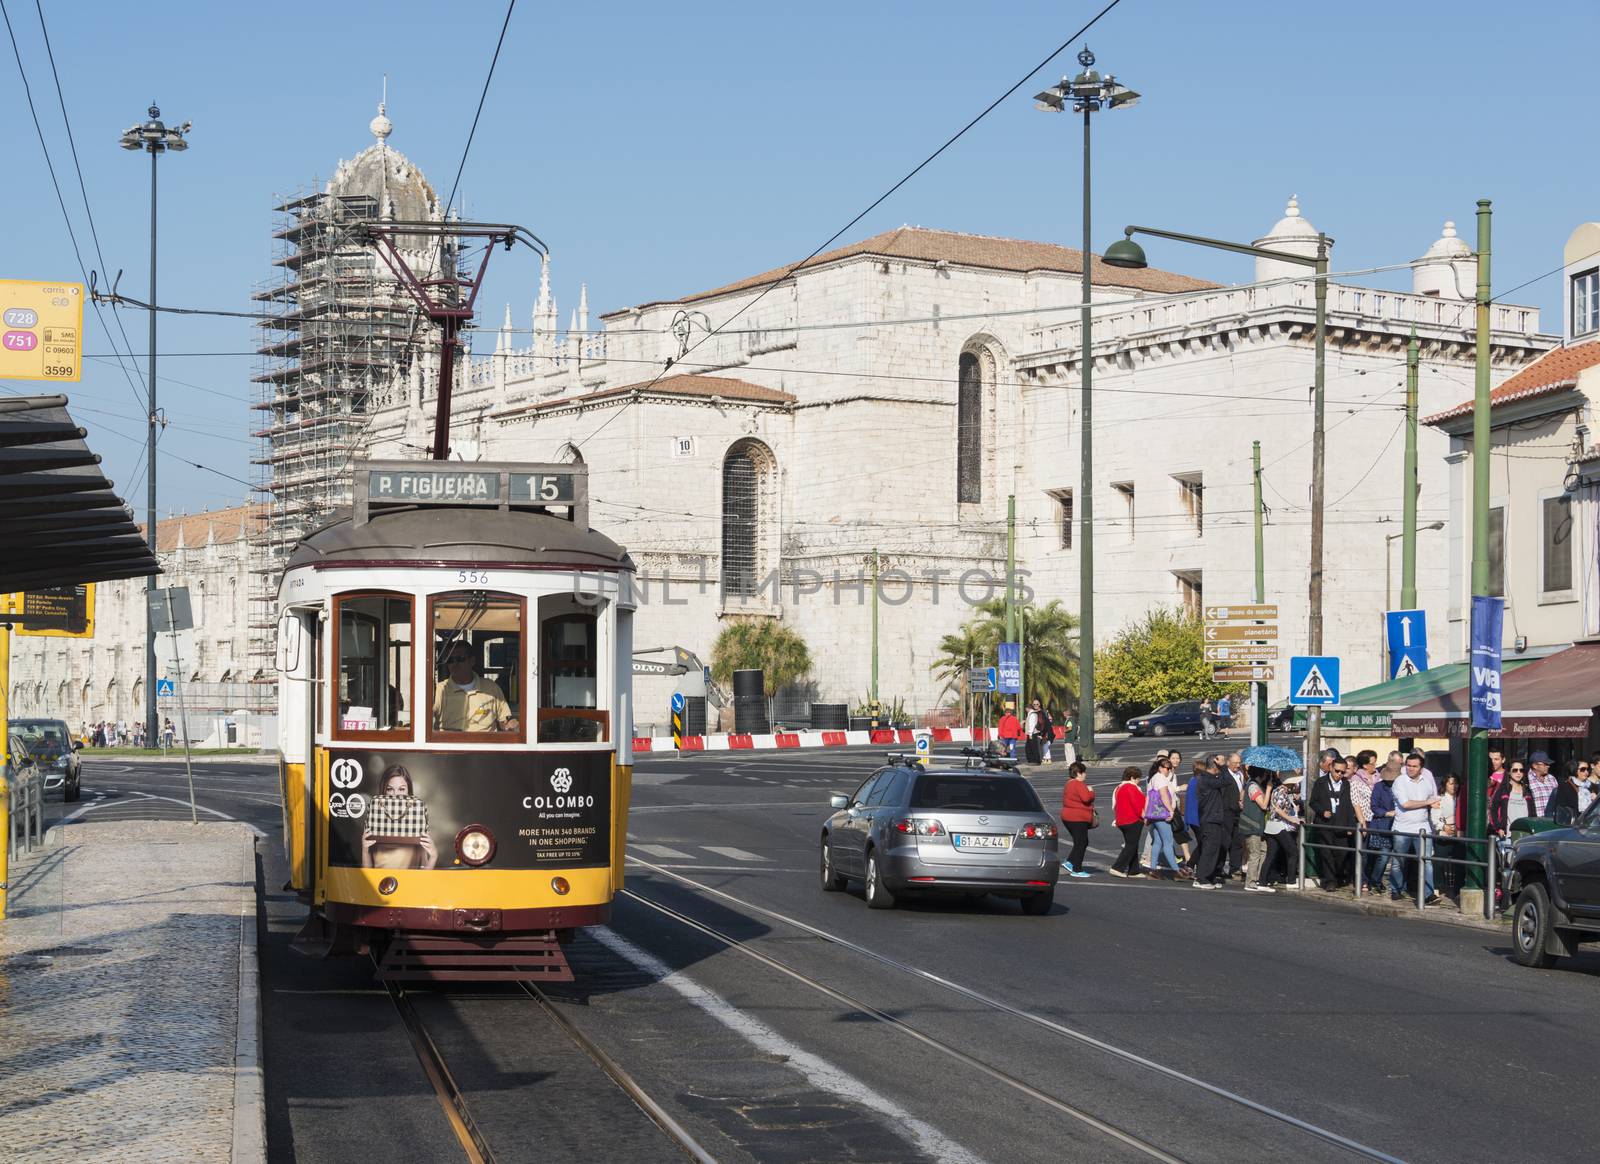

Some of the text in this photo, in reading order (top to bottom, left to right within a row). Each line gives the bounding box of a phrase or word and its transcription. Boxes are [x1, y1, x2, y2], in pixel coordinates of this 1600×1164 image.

[42, 286, 65, 294] carris
[8, 312, 34, 324] 728
[7, 335, 33, 347] 751
[45, 366, 73, 376] 3599
[679, 440, 690, 451] 10
[379, 476, 487, 495] P. FIGUEIRA
[526, 477, 559, 500] 15
[458, 571, 489, 584] 556
[1244, 628, 1277, 636] planetário
[632, 663, 665, 672] OLVO
[1000, 668, 1019, 678] vota
[1343, 715, 1359, 724] FLOR
[1361, 715, 1373, 724] DOS
[522, 795, 594, 809] COLOMBO
[519, 828, 540, 836] MORE
[542, 828, 560, 836] THAN
[573, 827, 596, 835] BRANDS
[529, 838, 537, 846] IN
[538, 838, 553, 846] ONE
[961, 836, 1003, 847] 61 AZ 44
